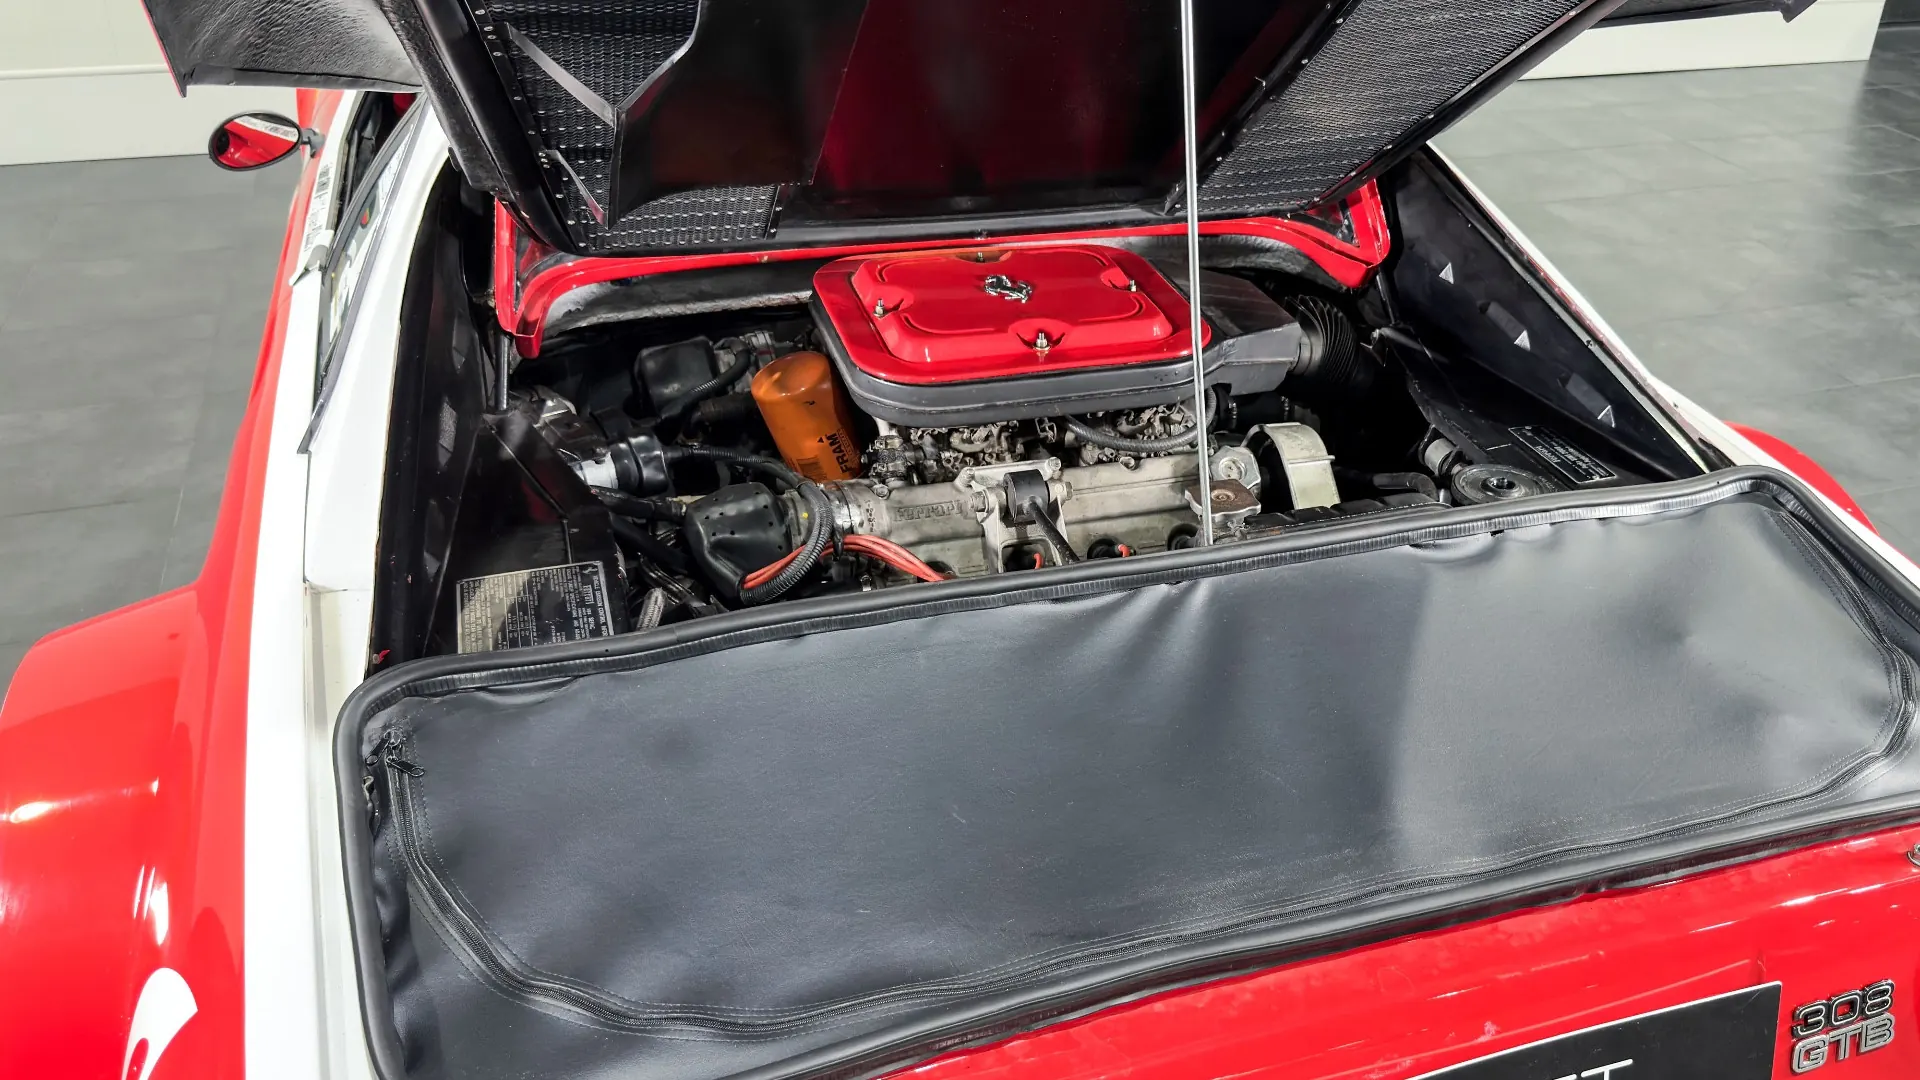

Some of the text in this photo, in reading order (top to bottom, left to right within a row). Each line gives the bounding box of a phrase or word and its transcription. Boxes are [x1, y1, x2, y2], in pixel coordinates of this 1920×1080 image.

[825, 433, 848, 473] FRAM
[1792, 979, 1895, 1040] 308
[1792, 1011, 1895, 1073] GTB
